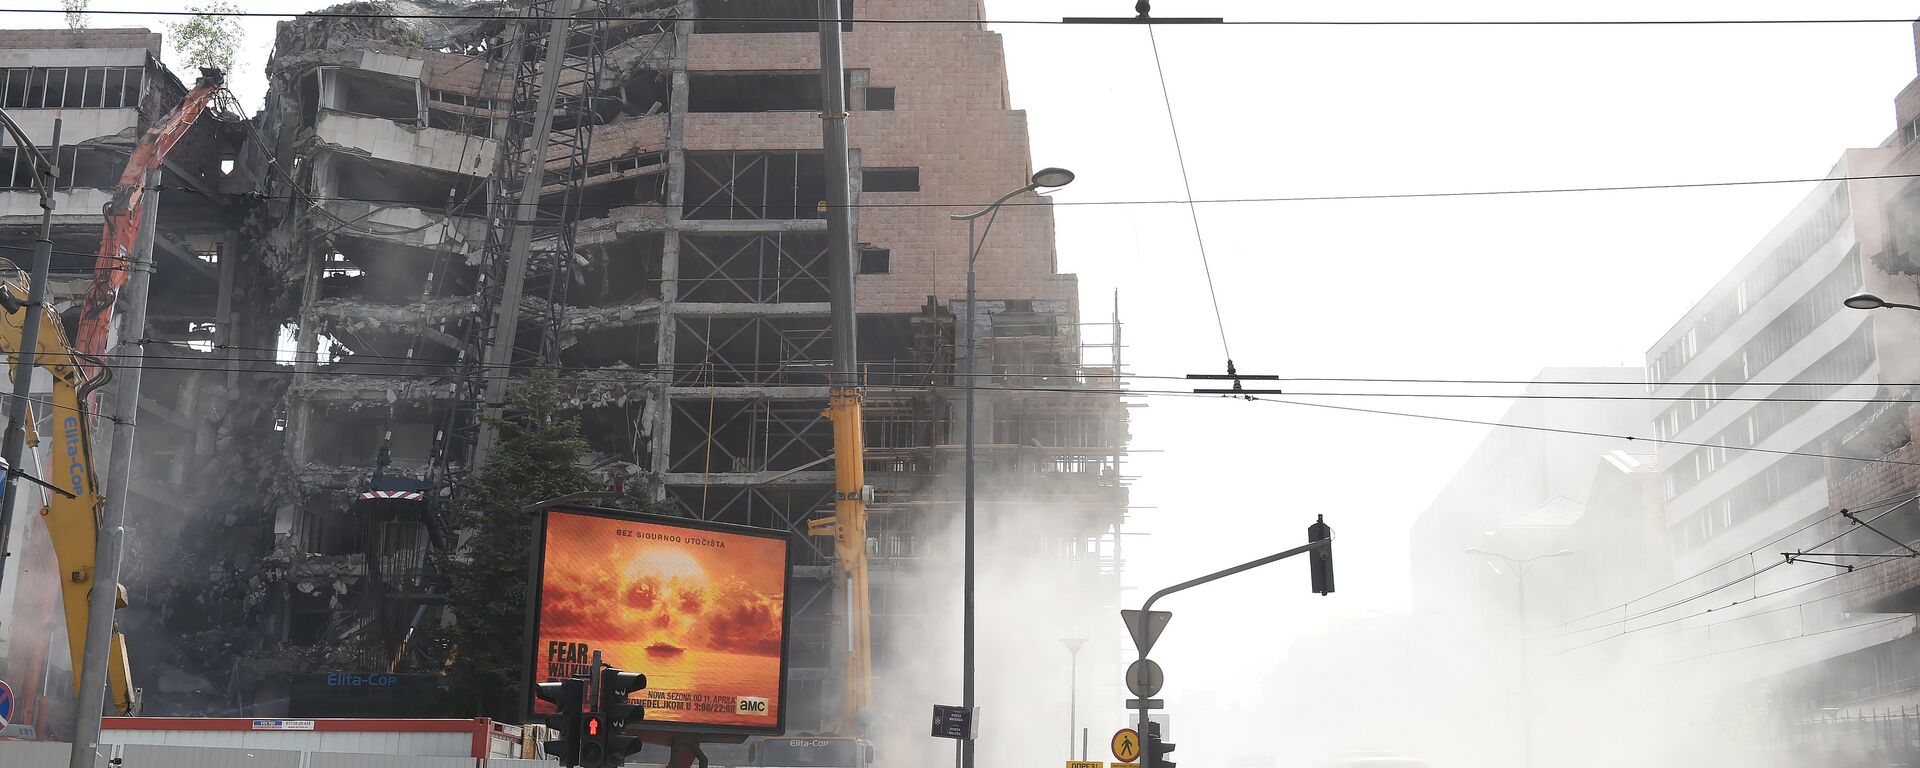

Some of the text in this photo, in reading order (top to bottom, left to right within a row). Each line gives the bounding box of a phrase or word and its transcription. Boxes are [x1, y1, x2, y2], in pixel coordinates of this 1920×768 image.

[616, 529, 726, 548] BEZ SIGURNOG UTOČIŠTA
[549, 641, 589, 664] FEAR
[648, 690, 665, 699] NOVA
[666, 692, 691, 702] SEZONA
[713, 695, 736, 705] APRILA
[686, 702, 692, 711] U
